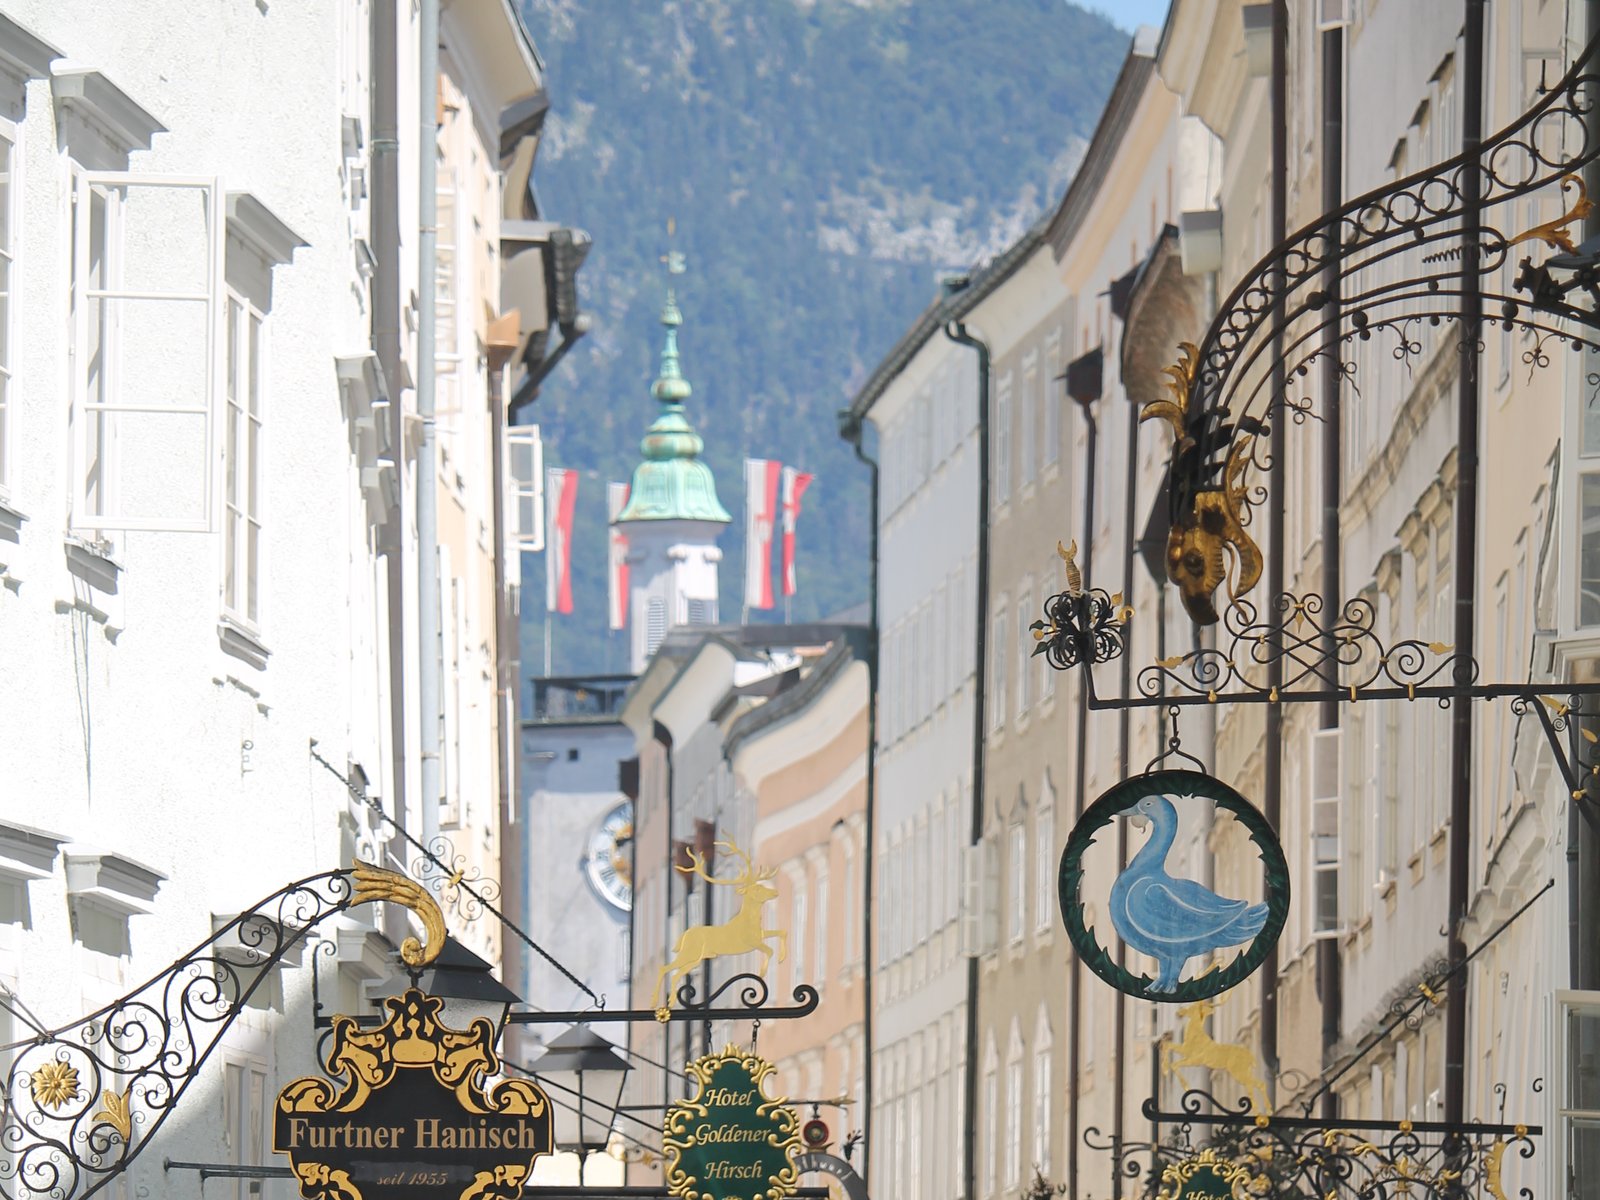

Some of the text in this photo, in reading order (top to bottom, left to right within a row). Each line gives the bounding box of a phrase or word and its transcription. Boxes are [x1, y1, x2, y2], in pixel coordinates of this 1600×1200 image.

[704, 1088, 757, 1107] Hotel
[288, 1118, 536, 1149] Furtner Hanisch
[695, 1123, 771, 1146] Goldener
[377, 1172, 448, 1186] seit 1955
[703, 1159, 763, 1180] Hirsch
